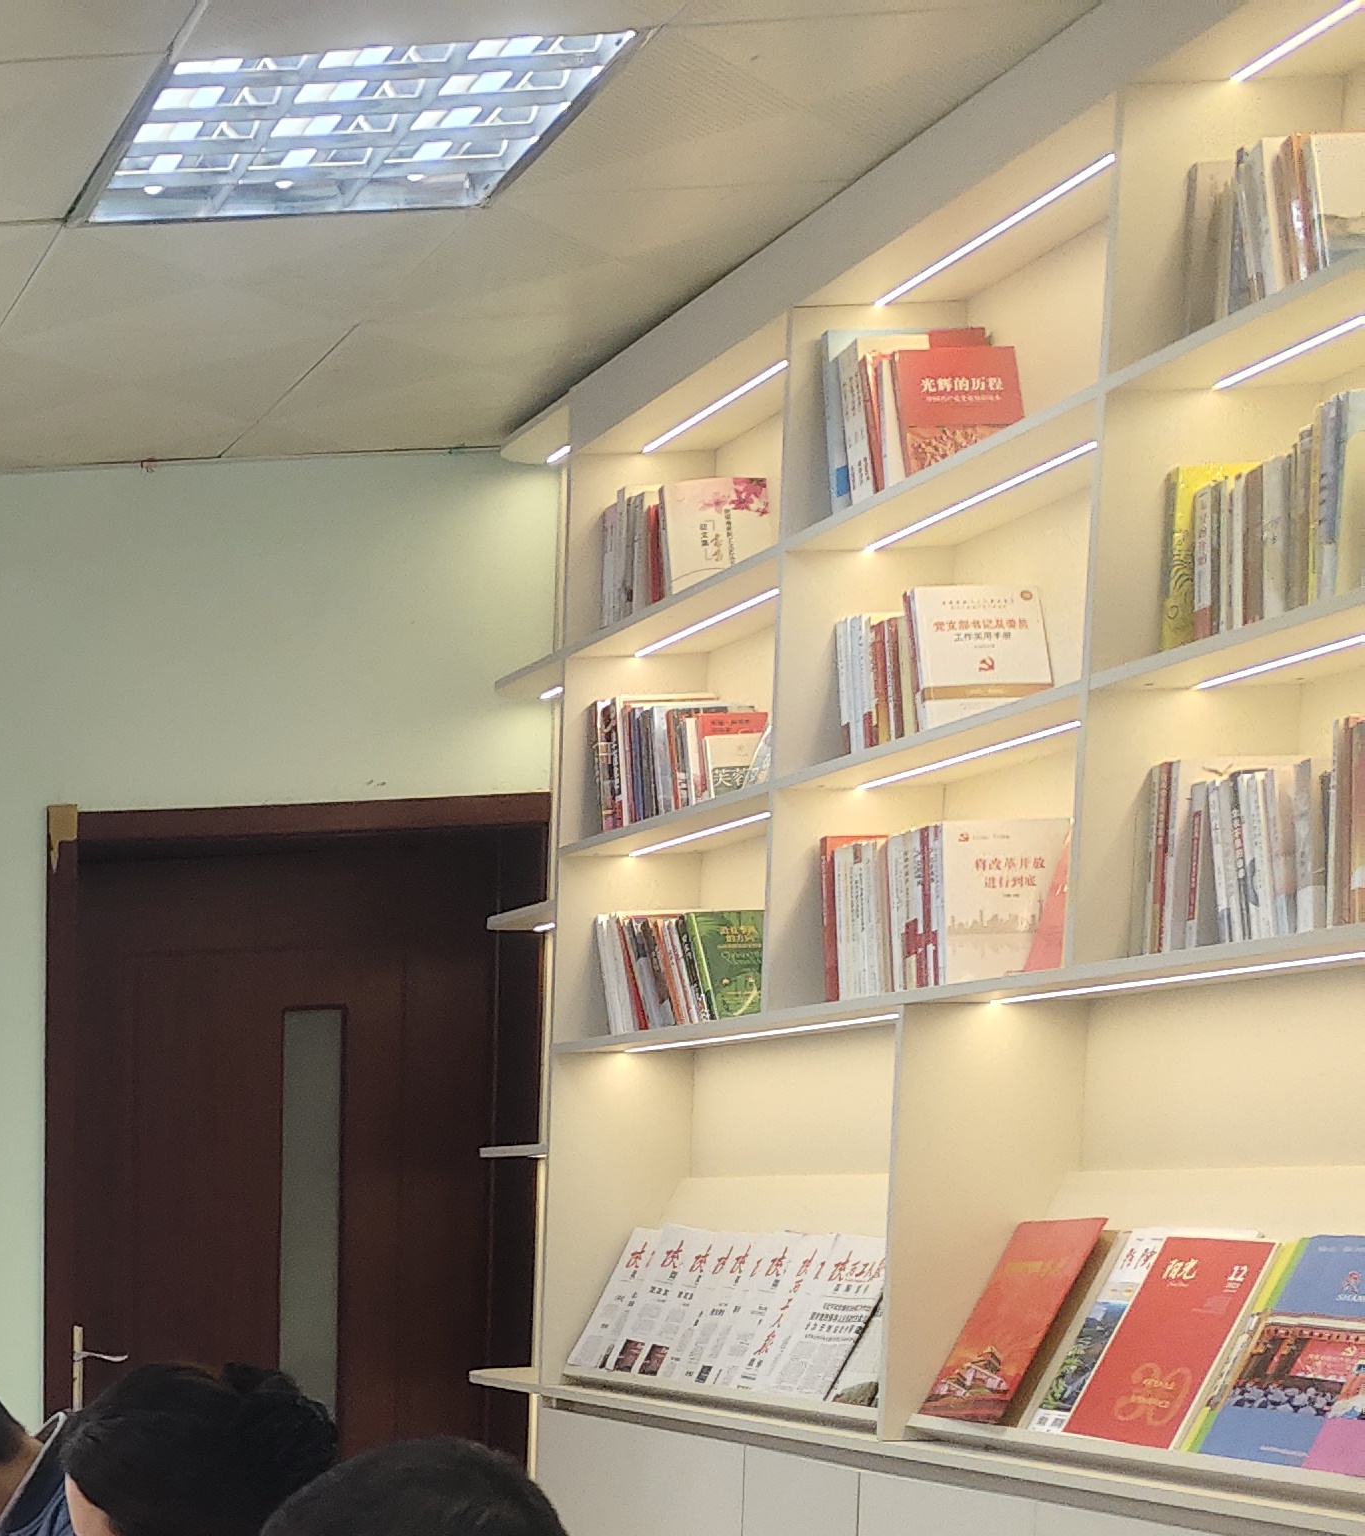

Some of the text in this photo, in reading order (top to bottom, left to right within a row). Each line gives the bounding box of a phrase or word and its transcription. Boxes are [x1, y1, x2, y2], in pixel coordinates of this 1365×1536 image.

[920, 376, 1004, 393] 光辉的历程
[974, 856, 1046, 871] 将改革开放
[983, 875, 1037, 889] 进行到底
